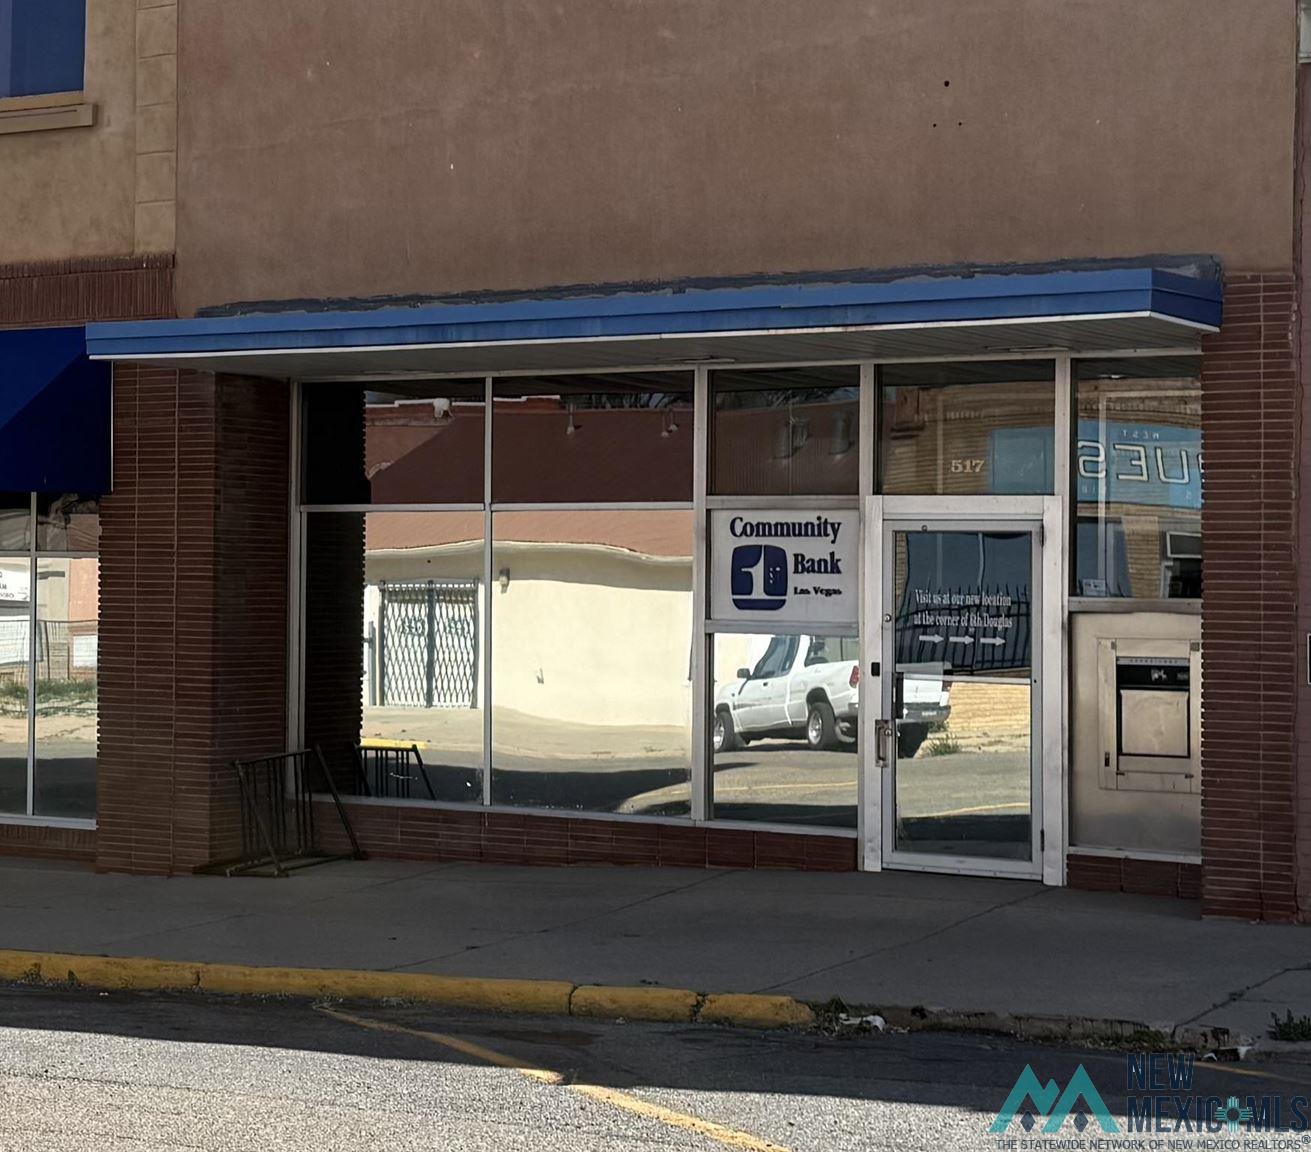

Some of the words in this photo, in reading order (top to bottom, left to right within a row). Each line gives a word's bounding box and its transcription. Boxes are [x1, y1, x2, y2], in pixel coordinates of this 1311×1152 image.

[951, 459, 985, 473] 517
[729, 515, 843, 544] Community
[793, 551, 842, 575] Bank
[793, 586, 811, 595] Las
[813, 586, 842, 597] Vegas
[915, 589, 931, 604] Visit
[932, 594, 942, 604] us
[942, 592, 950, 604] at
[951, 594, 964, 605] our
[965, 594, 981, 605] new
[982, 591, 1012, 606] location
[913, 611, 921, 625] at
[922, 610, 934, 625] the
[935, 614, 960, 626] corner
[961, 612, 969, 627] of
[983, 612, 1013, 631] Douglas
